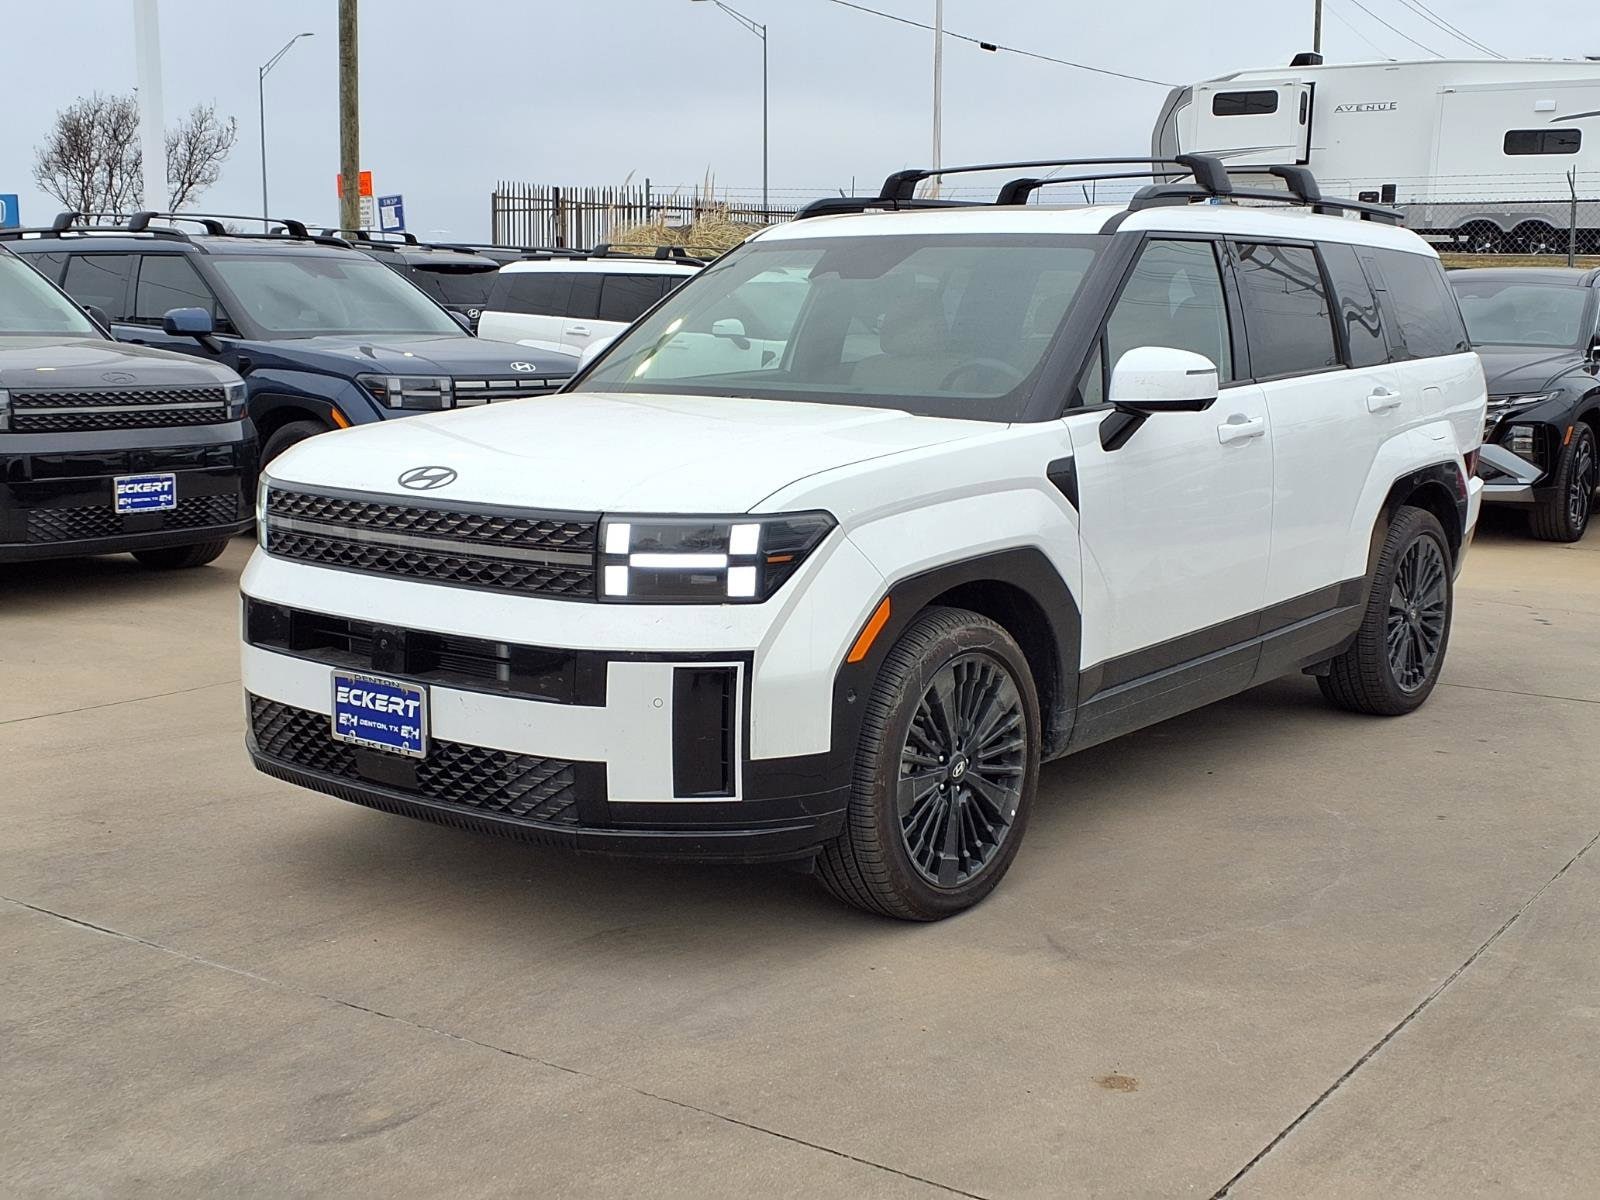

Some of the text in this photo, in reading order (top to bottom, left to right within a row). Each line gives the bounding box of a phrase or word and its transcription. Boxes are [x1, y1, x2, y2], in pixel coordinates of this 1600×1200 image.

[1334, 101, 1398, 114] AVENUE
[117, 481, 172, 494] ECKERT
[354, 674, 400, 688] DENTON
[337, 686, 420, 718] ECKERT
[389, 725, 399, 733] TX
